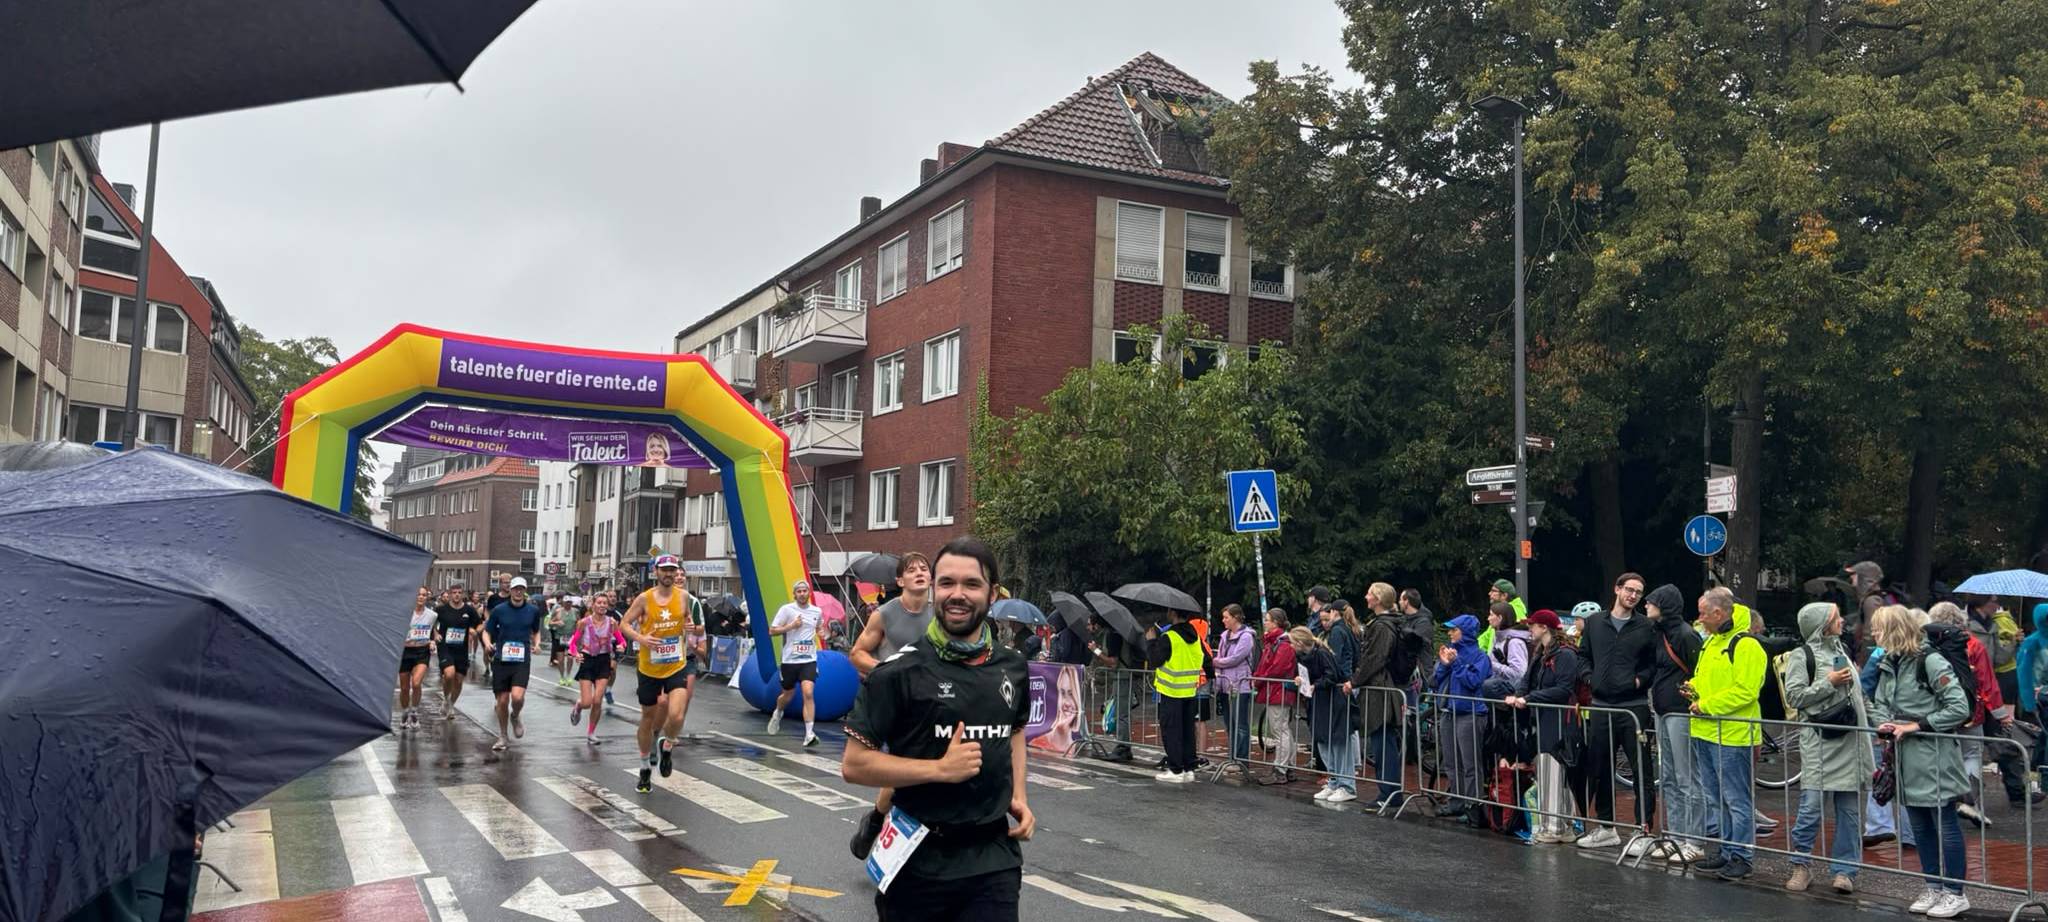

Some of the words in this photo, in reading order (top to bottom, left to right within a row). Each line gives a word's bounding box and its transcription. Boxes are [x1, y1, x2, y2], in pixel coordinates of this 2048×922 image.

[430, 420, 455, 432] Dein
[457, 423, 505, 437] nächster
[507, 428, 548, 441] Schritt.
[609, 434, 626, 442] DEIN
[429, 434, 474, 449] BEWIRB
[476, 441, 508, 453] DICH!
[571, 441, 627, 462] Talent
